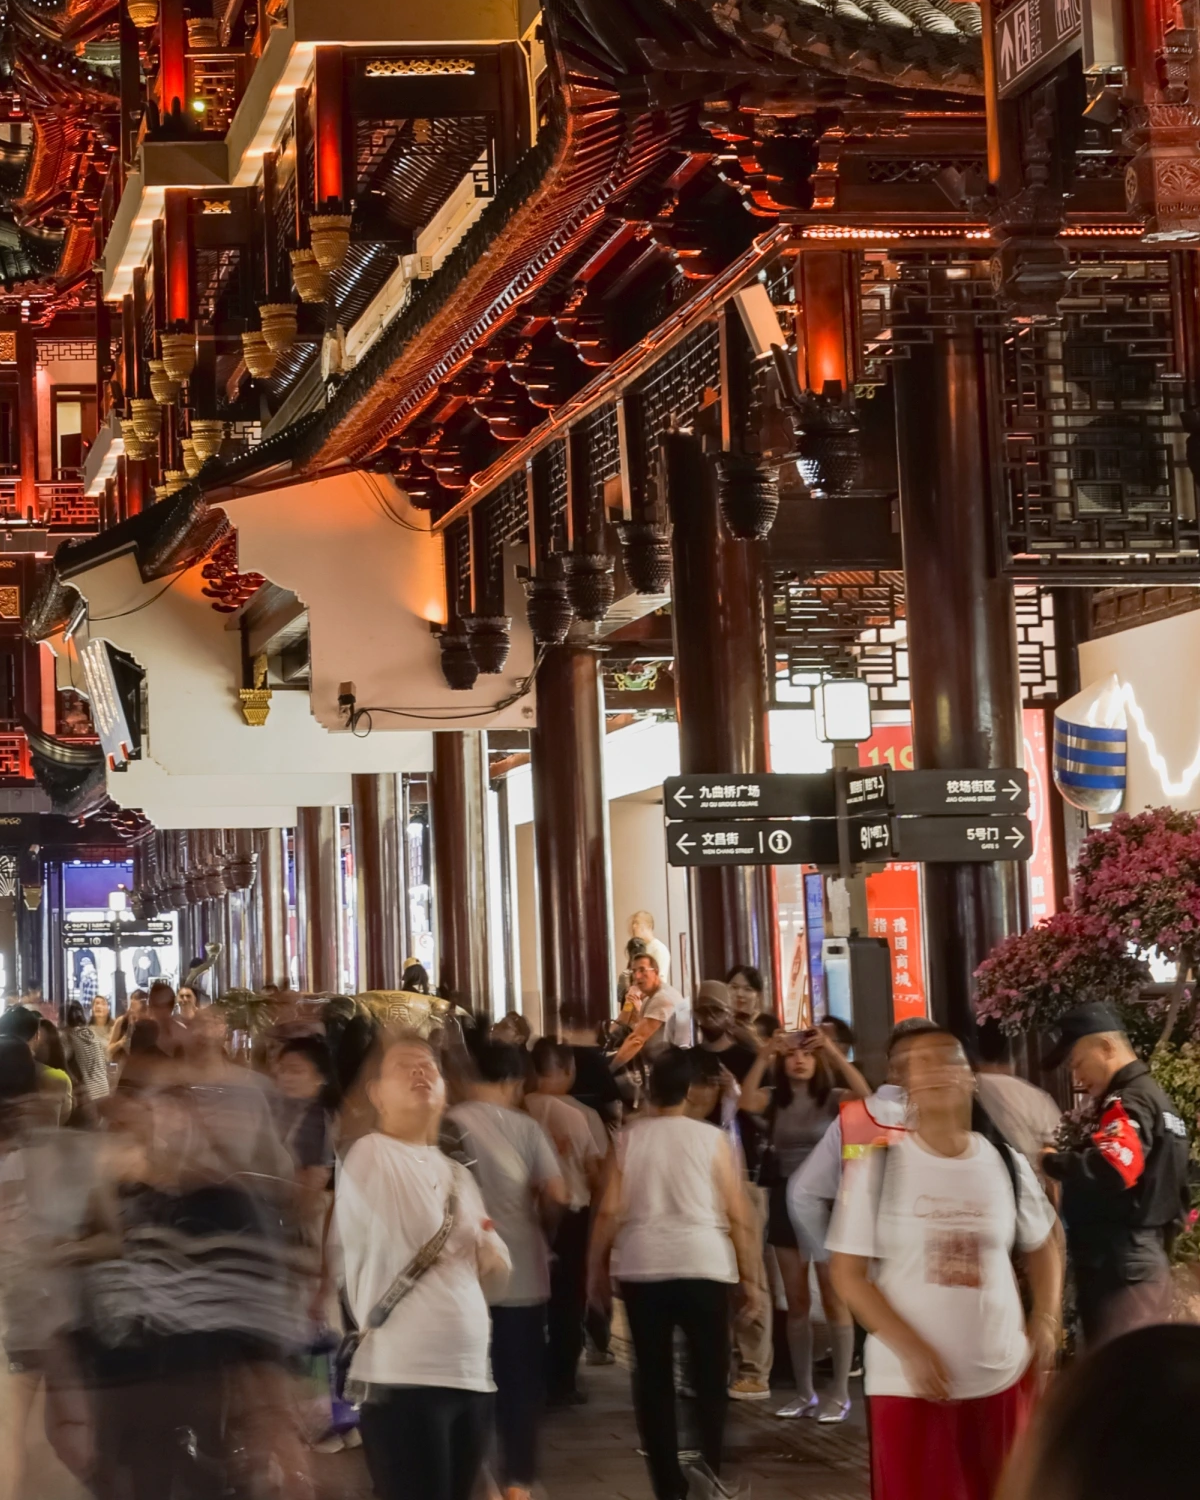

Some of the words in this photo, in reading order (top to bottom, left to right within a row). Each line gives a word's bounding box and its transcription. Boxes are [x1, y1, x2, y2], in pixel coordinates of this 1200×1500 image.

[699, 785, 760, 798] 九曲桥广场
[946, 780, 996, 793] 校场街区
[702, 832, 739, 846] 文昌街
[966, 827, 999, 840] 5号门
